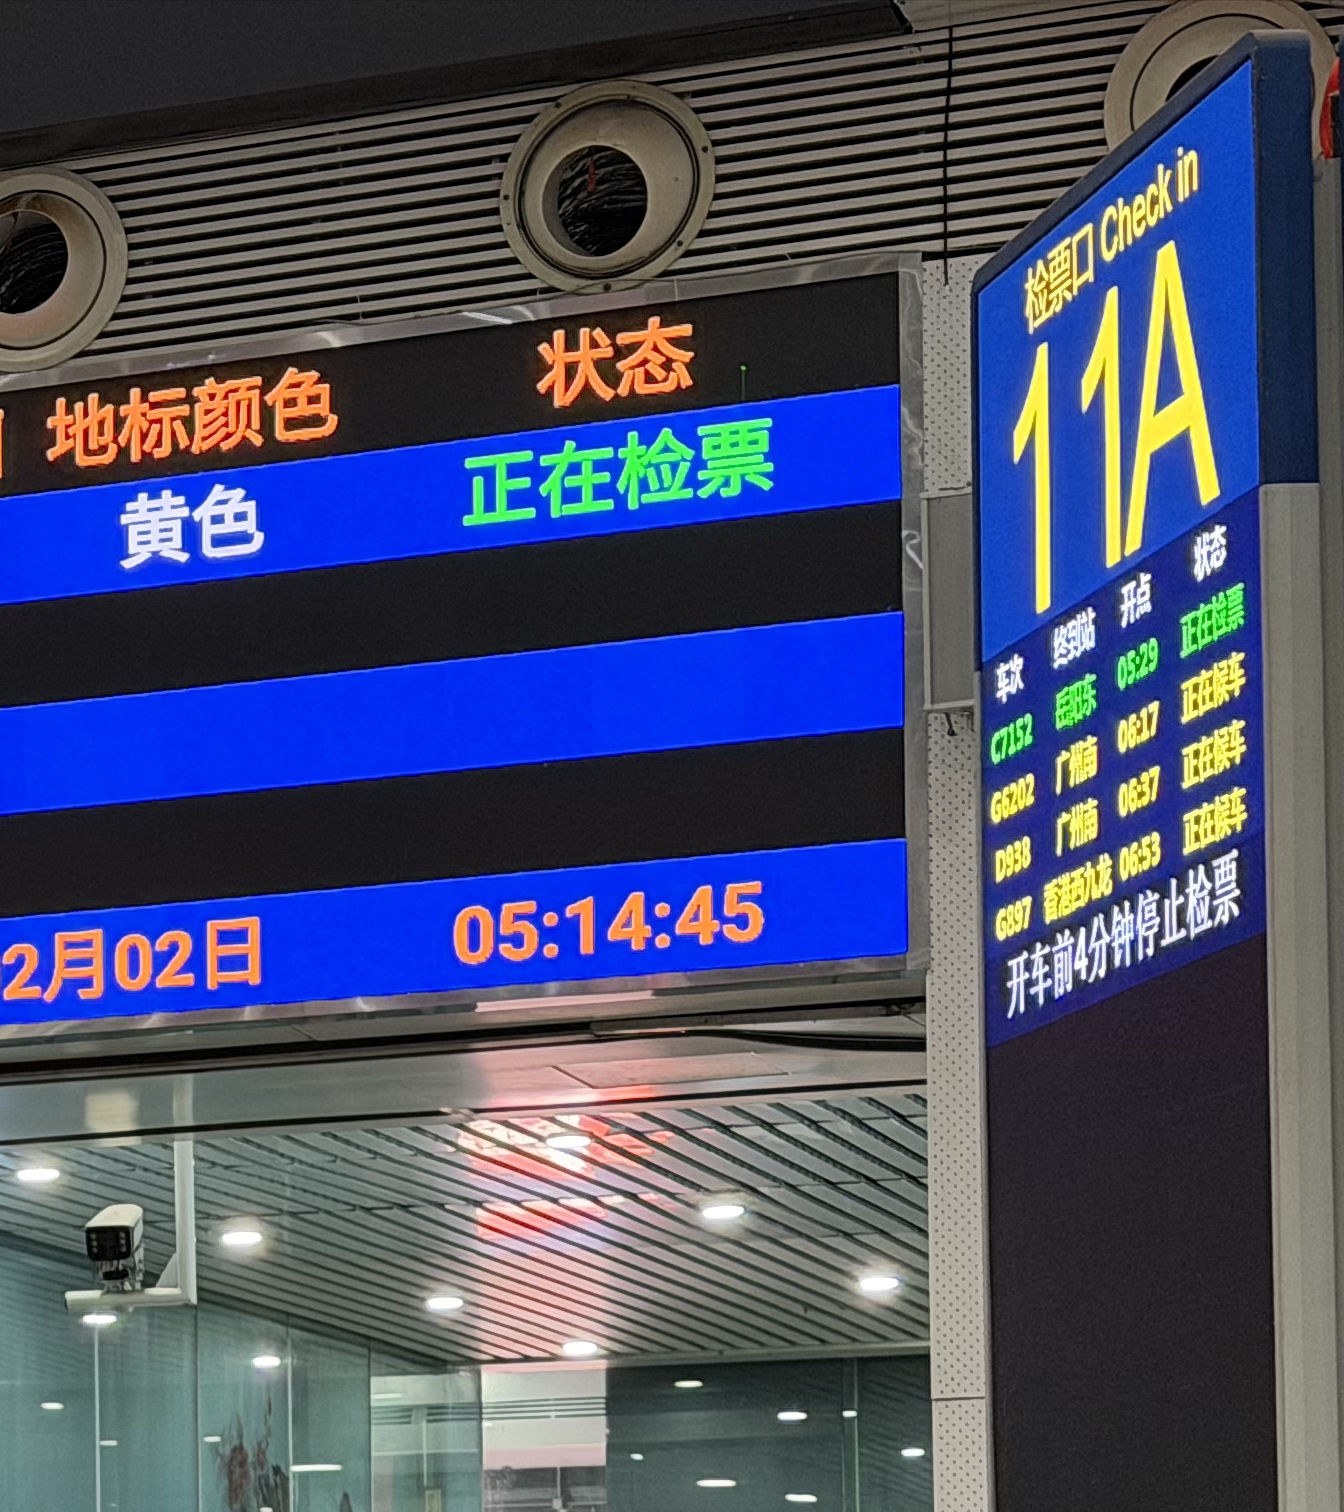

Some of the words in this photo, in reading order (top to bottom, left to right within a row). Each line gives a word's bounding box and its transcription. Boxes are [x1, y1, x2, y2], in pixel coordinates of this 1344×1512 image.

[1023, 223, 1095, 335] 检票口
[1099, 162, 1174, 262] Check
[1176, 146, 1200, 203] in
[45, 366, 340, 468] 地标颜色
[535, 315, 696, 409] 状态
[1012, 239, 1221, 615] 11A
[118, 482, 266, 571] 黄色
[461, 416, 776, 528] 正在检票
[990, 712, 1034, 765] C7152
[1054, 672, 1098, 731] 岳阳东
[1116, 637, 1160, 691] 05:29
[1179, 582, 1246, 660] 正在检票
[996, 653, 1024, 704] 车次
[1052, 606, 1097, 670] 终到站
[1120, 572, 1153, 629] 开点
[1193, 524, 1228, 583] 状态
[989, 772, 1036, 826] G6202
[1055, 734, 1099, 796] 广州南
[1116, 700, 1161, 754] 06:17
[1180, 651, 1248, 725] 正在候车
[994, 835, 1032, 885] D938
[1055, 797, 1099, 858] 广州南
[1117, 765, 1162, 819] 06:37
[1180, 719, 1248, 791] 正在候车
[452, 879, 767, 968] 05:14:45
[994, 895, 1033, 942] G897
[1042, 851, 1115, 925] 香港西九龙
[1118, 830, 1162, 883] 06:53
[1181, 785, 1249, 857] 正在候车
[1005, 847, 1242, 1020] 开车前4分钟停止检票
